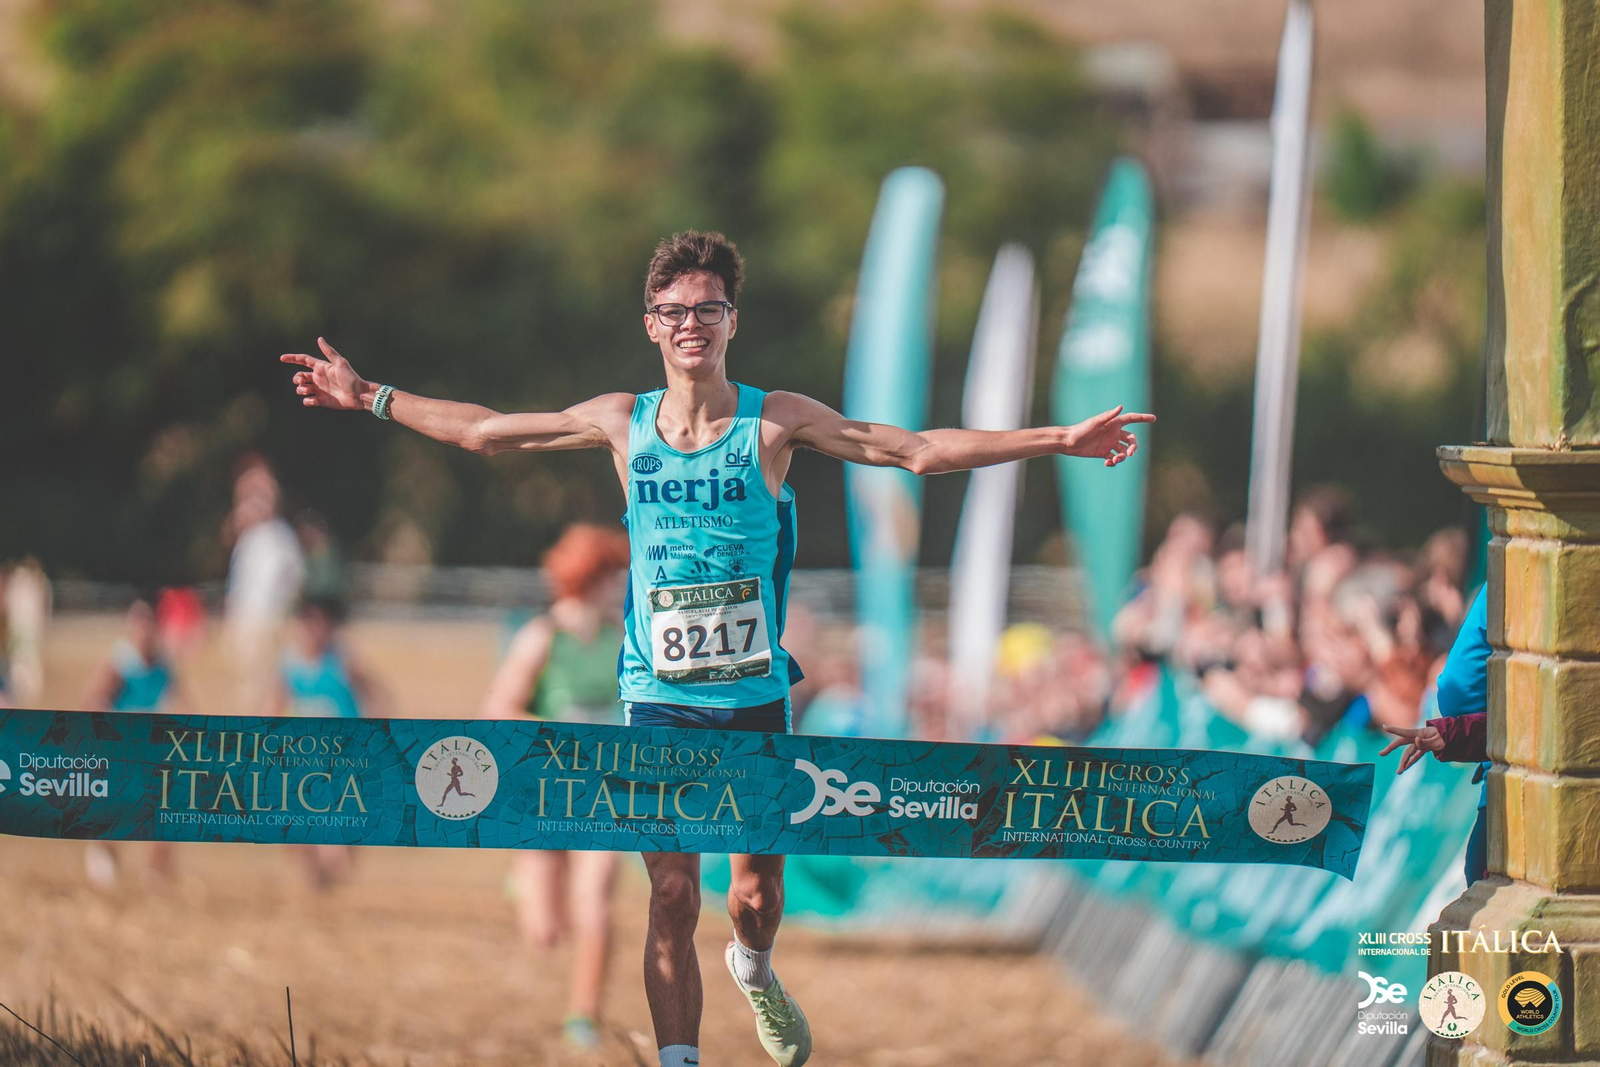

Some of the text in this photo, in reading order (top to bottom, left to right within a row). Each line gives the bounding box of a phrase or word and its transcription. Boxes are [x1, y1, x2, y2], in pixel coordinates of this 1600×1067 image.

[635, 468, 747, 511] nerja
[655, 515, 733, 529] ATLETISMO
[670, 551, 696, 560] Málaga
[680, 587, 734, 603] ITÁLICA
[662, 617, 757, 661] 8217
[163, 731, 343, 763] XLIII CROSS
[422, 740, 492, 773] ITÁLICA
[542, 739, 721, 772] XLIII CROSS
[19, 753, 109, 771] Diputación
[1009, 758, 1191, 789] XLIII CROSS
[19, 772, 109, 798] Sevilla
[159, 762, 369, 813] ITÁLICA
[536, 771, 745, 822] ITÁLICA
[890, 777, 980, 796] Diputación
[1107, 781, 1218, 801] INTERNACIONAL
[1256, 779, 1326, 809] ITÁLICA
[160, 812, 369, 828] INTERNATIONAL CROSS COUNTRY
[888, 795, 979, 820] Sevilla
[1002, 786, 1212, 839] ITÁLICA
[537, 820, 744, 837] INTERNATIONAL CROSS COUNTRY
[1002, 831, 1211, 850] INTERNATIONAL CROSS COUNTRY
